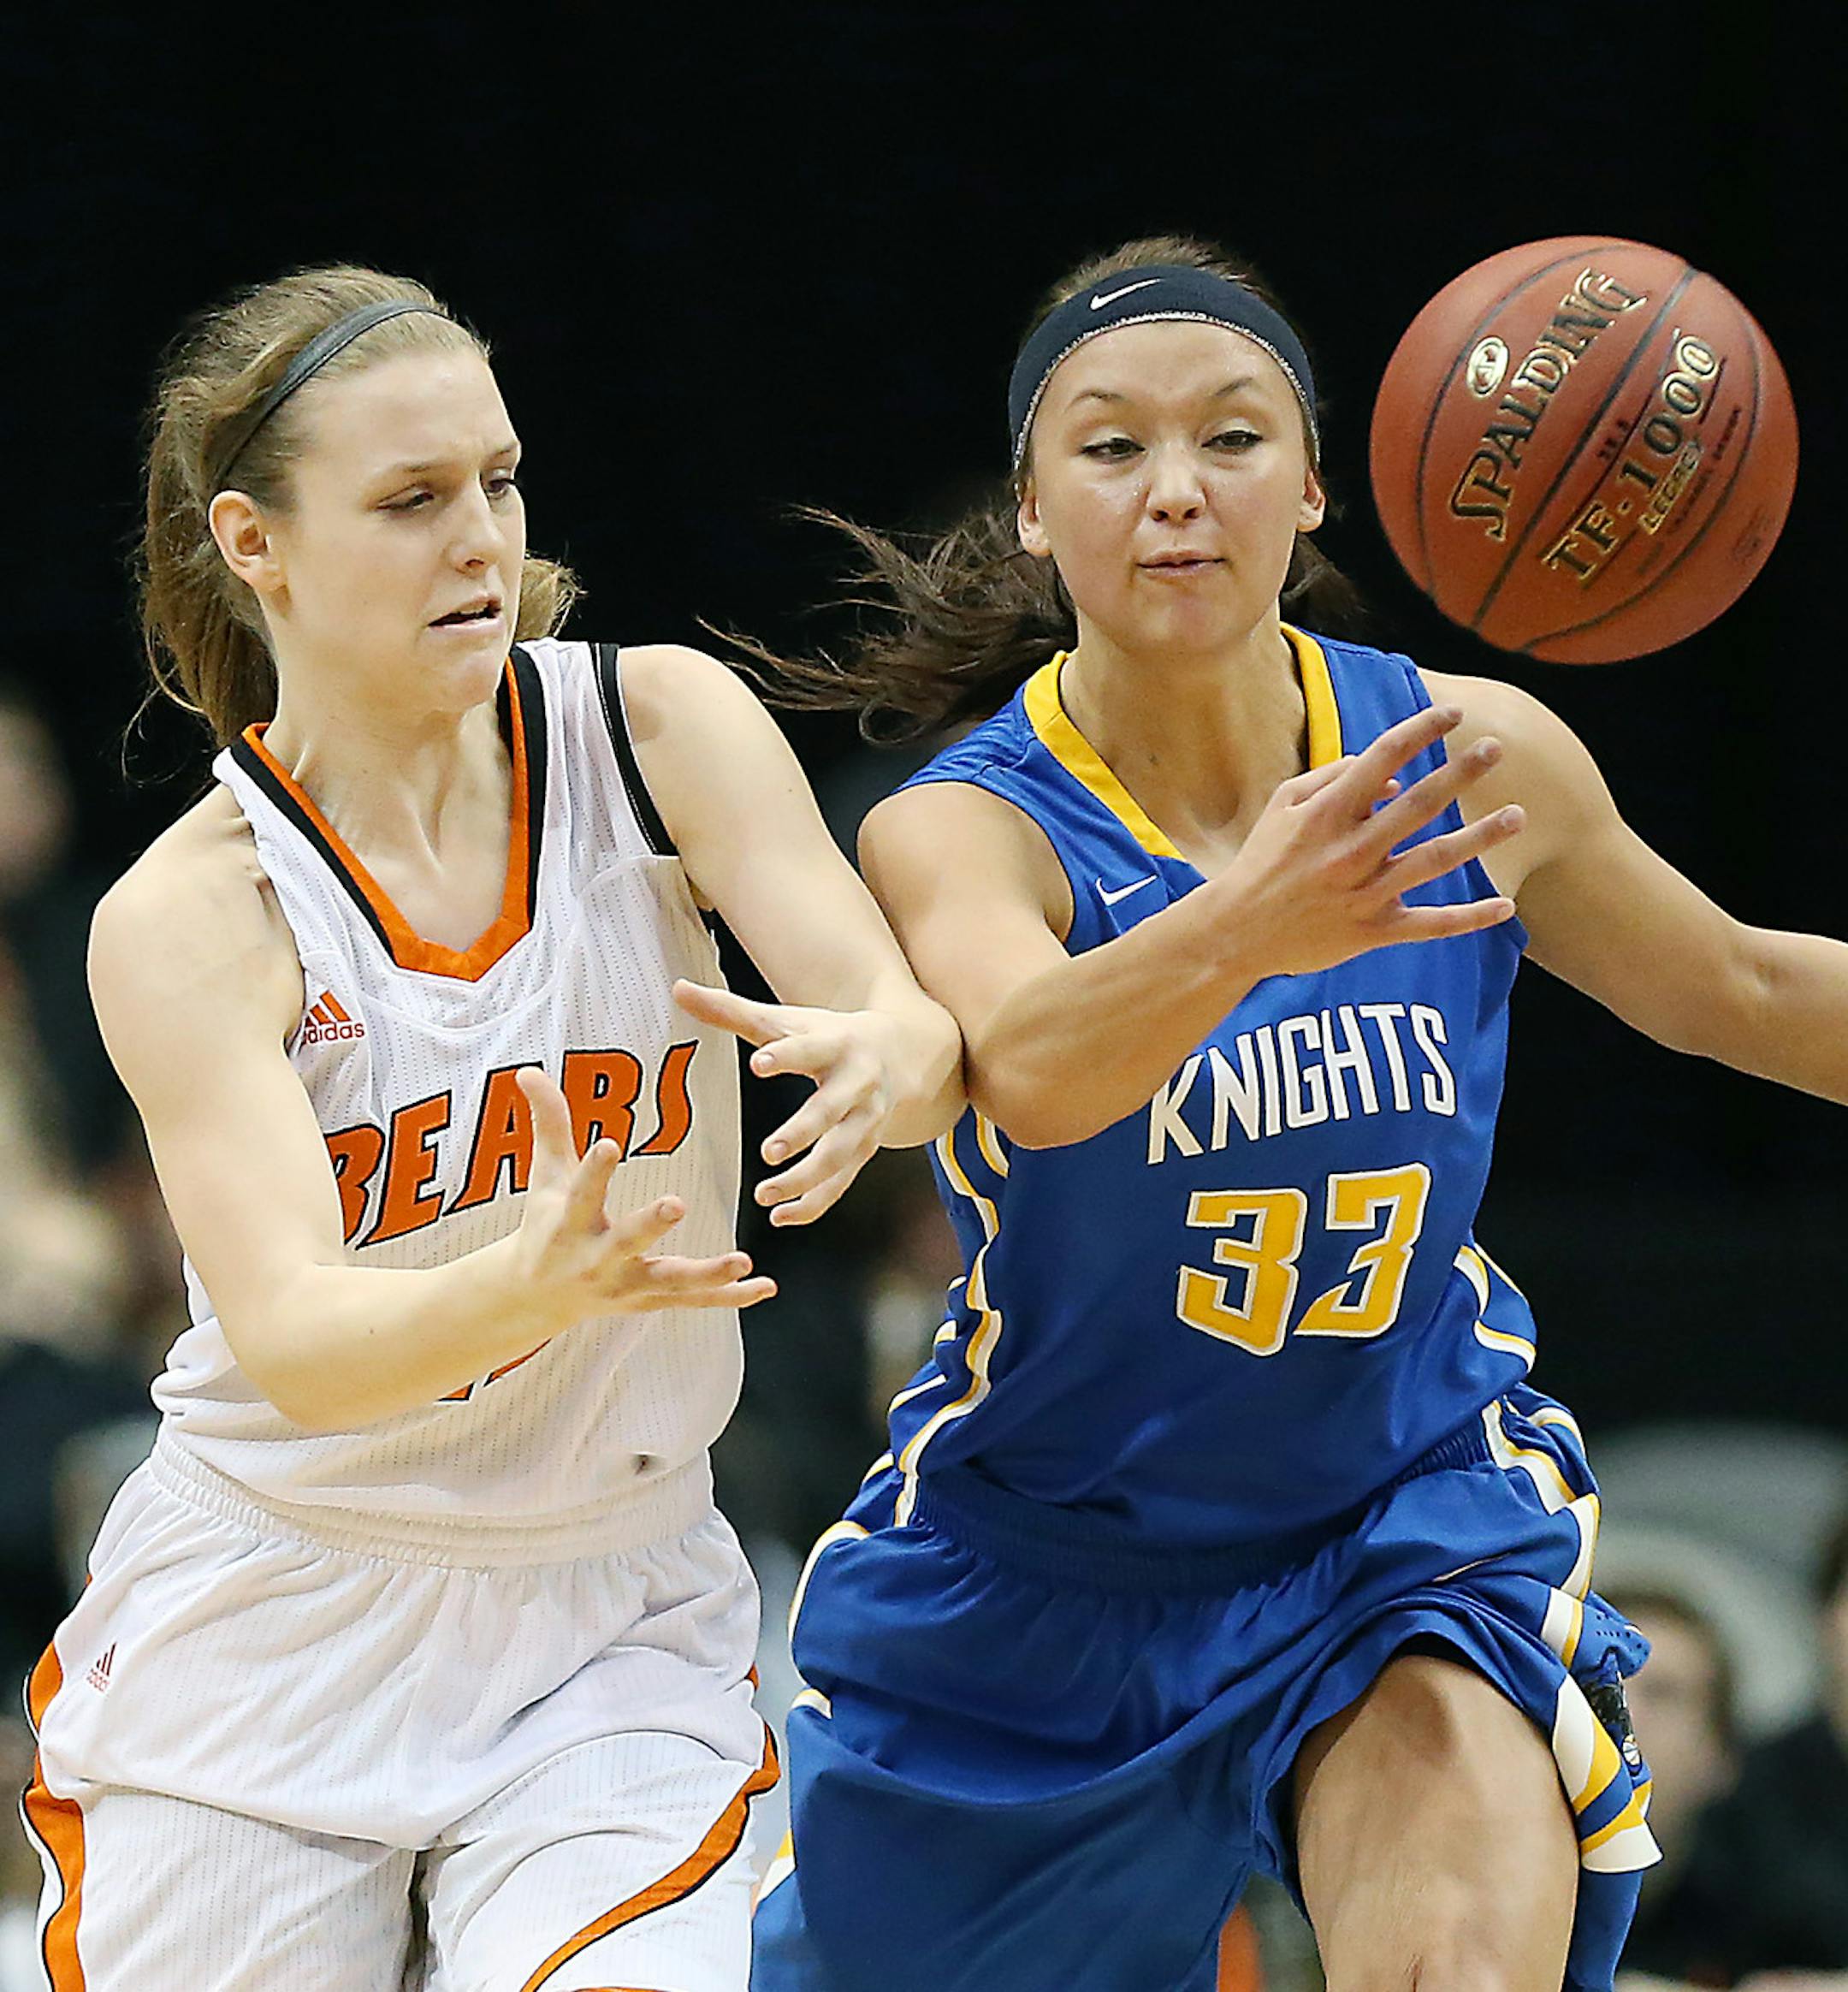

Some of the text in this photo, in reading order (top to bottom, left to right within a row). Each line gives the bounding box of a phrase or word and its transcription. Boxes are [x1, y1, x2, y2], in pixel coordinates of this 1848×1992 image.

[1450, 266, 1648, 542] SPALDING
[1541, 335, 1720, 582] TF-1000
[323, 1038, 700, 1251] BEARS
[1146, 1002, 1456, 1165] KNIGHTS
[1176, 1161, 1432, 1358] 33
